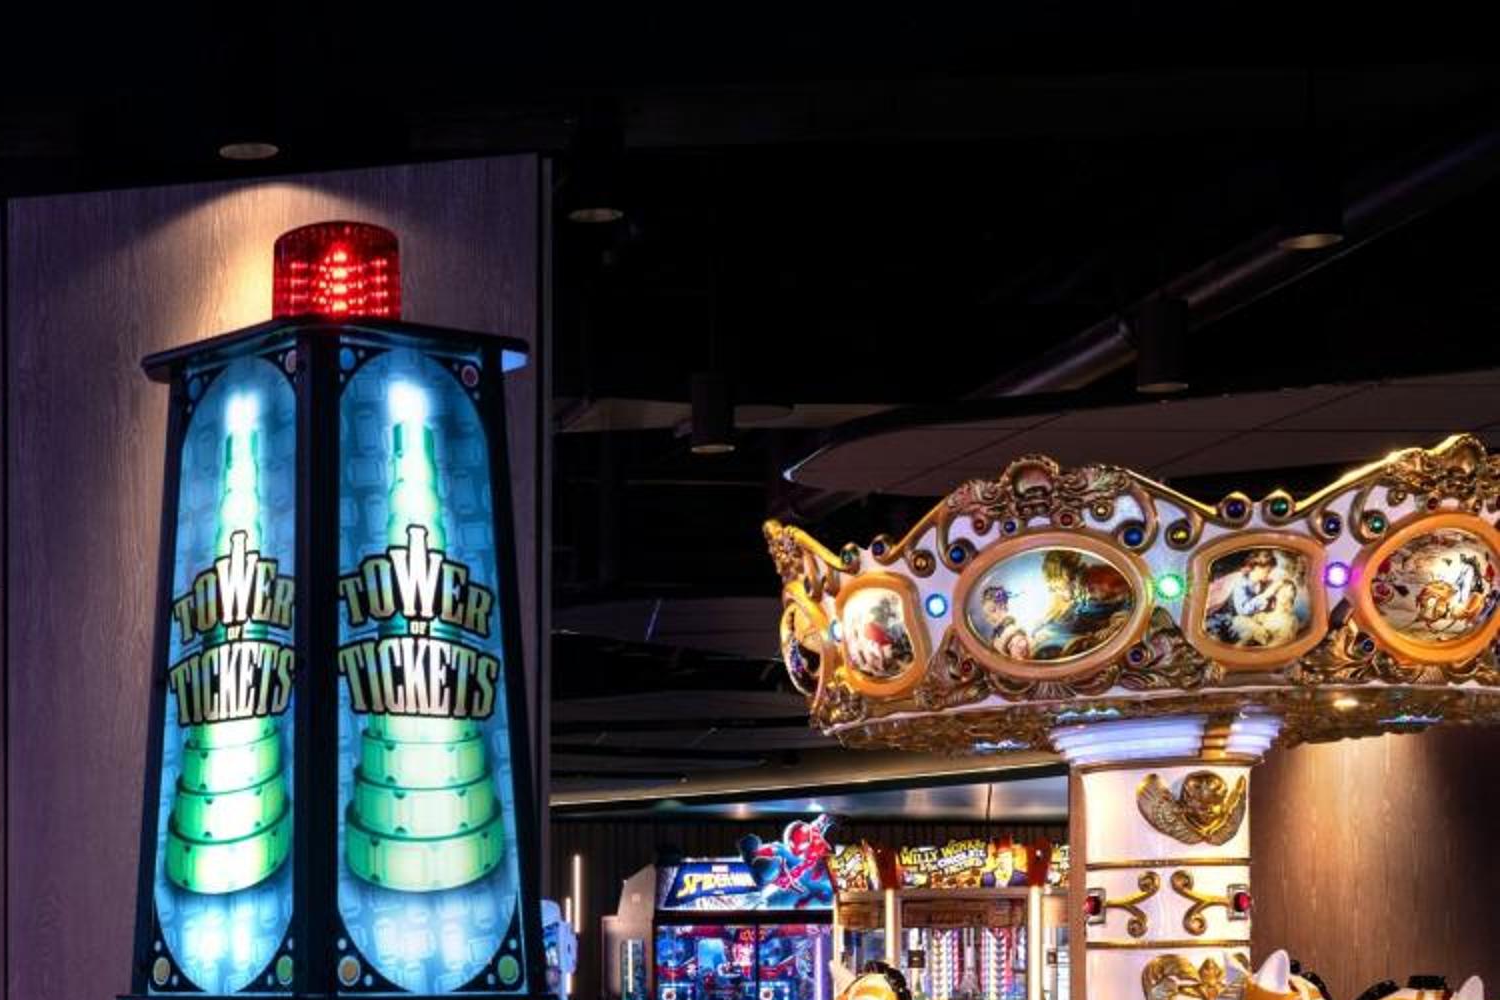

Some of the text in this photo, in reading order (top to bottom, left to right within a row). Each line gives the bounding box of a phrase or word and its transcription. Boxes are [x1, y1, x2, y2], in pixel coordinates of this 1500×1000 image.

[172, 530, 295, 642] TOWER
[338, 525, 493, 634] TOWER
[227, 622, 240, 638] OF
[410, 619, 427, 635] OF
[169, 640, 295, 726] TICKETS
[338, 640, 500, 719] TICKETS
